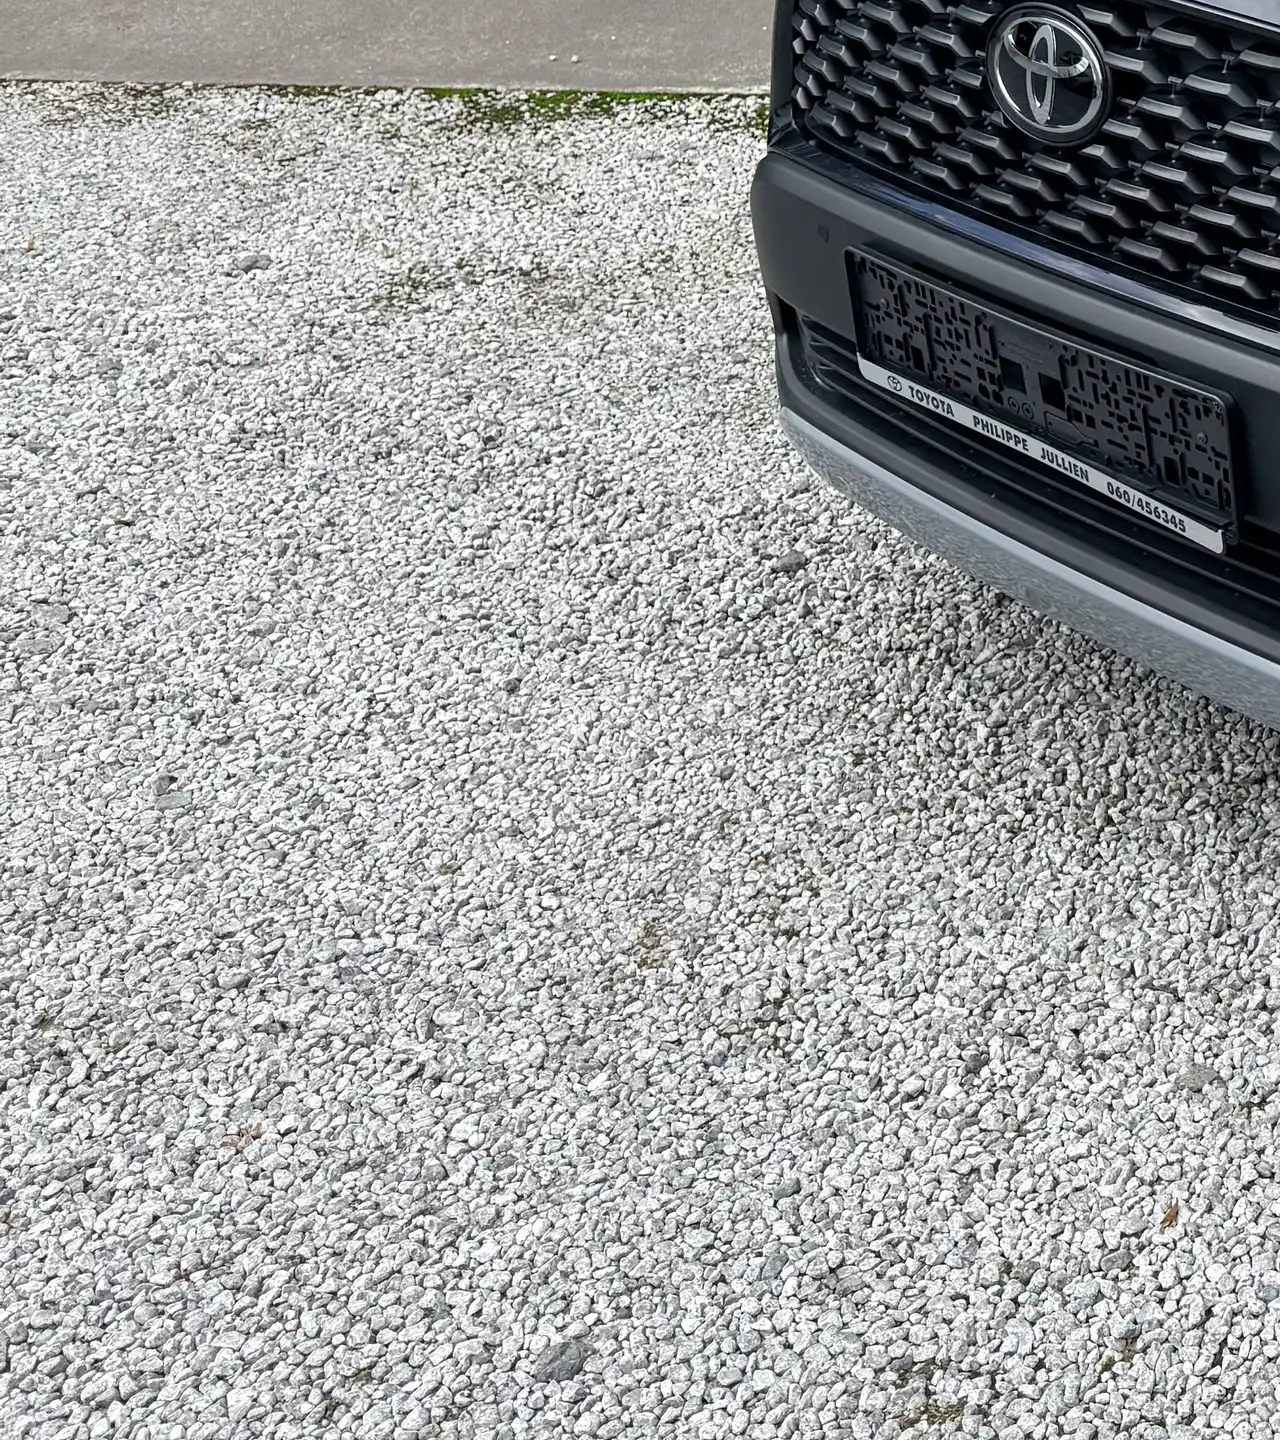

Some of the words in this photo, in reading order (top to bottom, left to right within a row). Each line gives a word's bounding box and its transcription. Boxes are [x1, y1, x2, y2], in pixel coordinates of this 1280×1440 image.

[908, 385, 955, 418] TOYOTA
[973, 415, 1029, 452] PHILIPPE
[1040, 447, 1090, 483] JULLIEN
[1106, 481, 1187, 534] 060/456345
